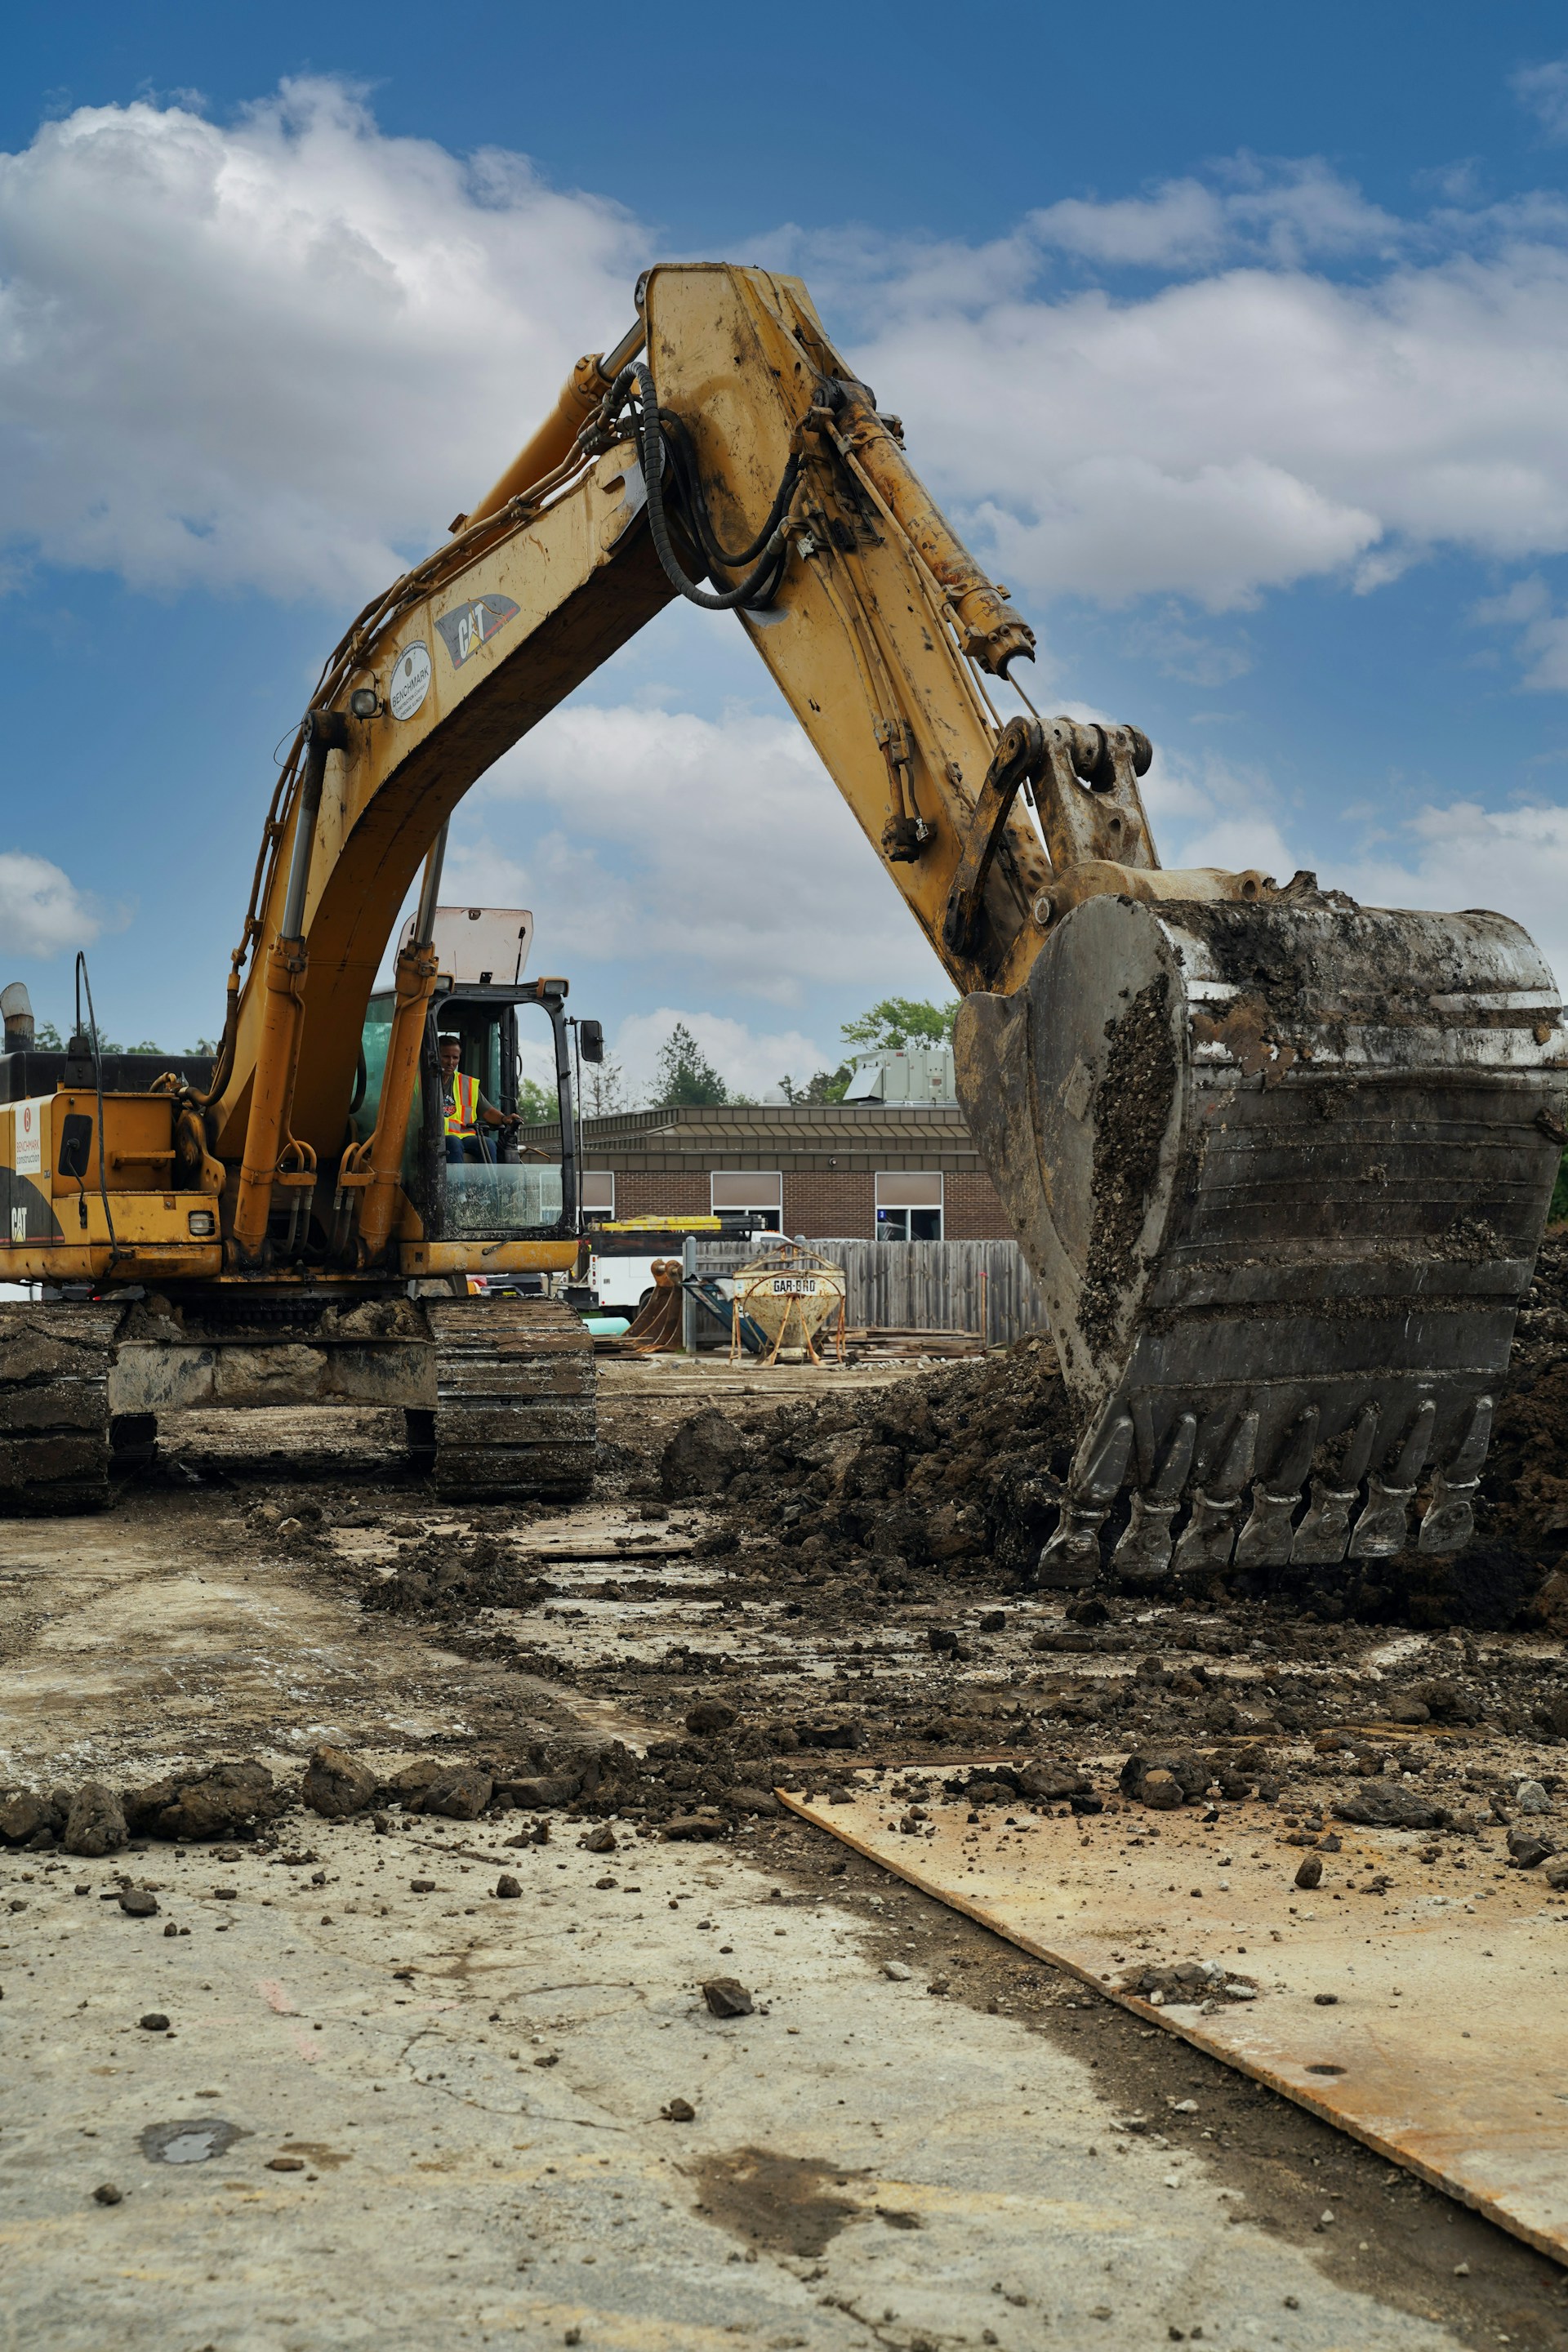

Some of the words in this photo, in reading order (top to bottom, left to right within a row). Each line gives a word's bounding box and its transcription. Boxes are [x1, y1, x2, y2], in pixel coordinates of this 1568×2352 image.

[458, 603, 484, 659] CAT
[392, 666, 429, 707] BENCHMARK
[395, 693, 415, 714] CONSTRUCTION
[412, 695, 423, 708] ILLINOIS
[16, 1138, 40, 1152] BENCHMARK
[16, 1152, 40, 1165] construction
[11, 1207, 27, 1241] CAT
